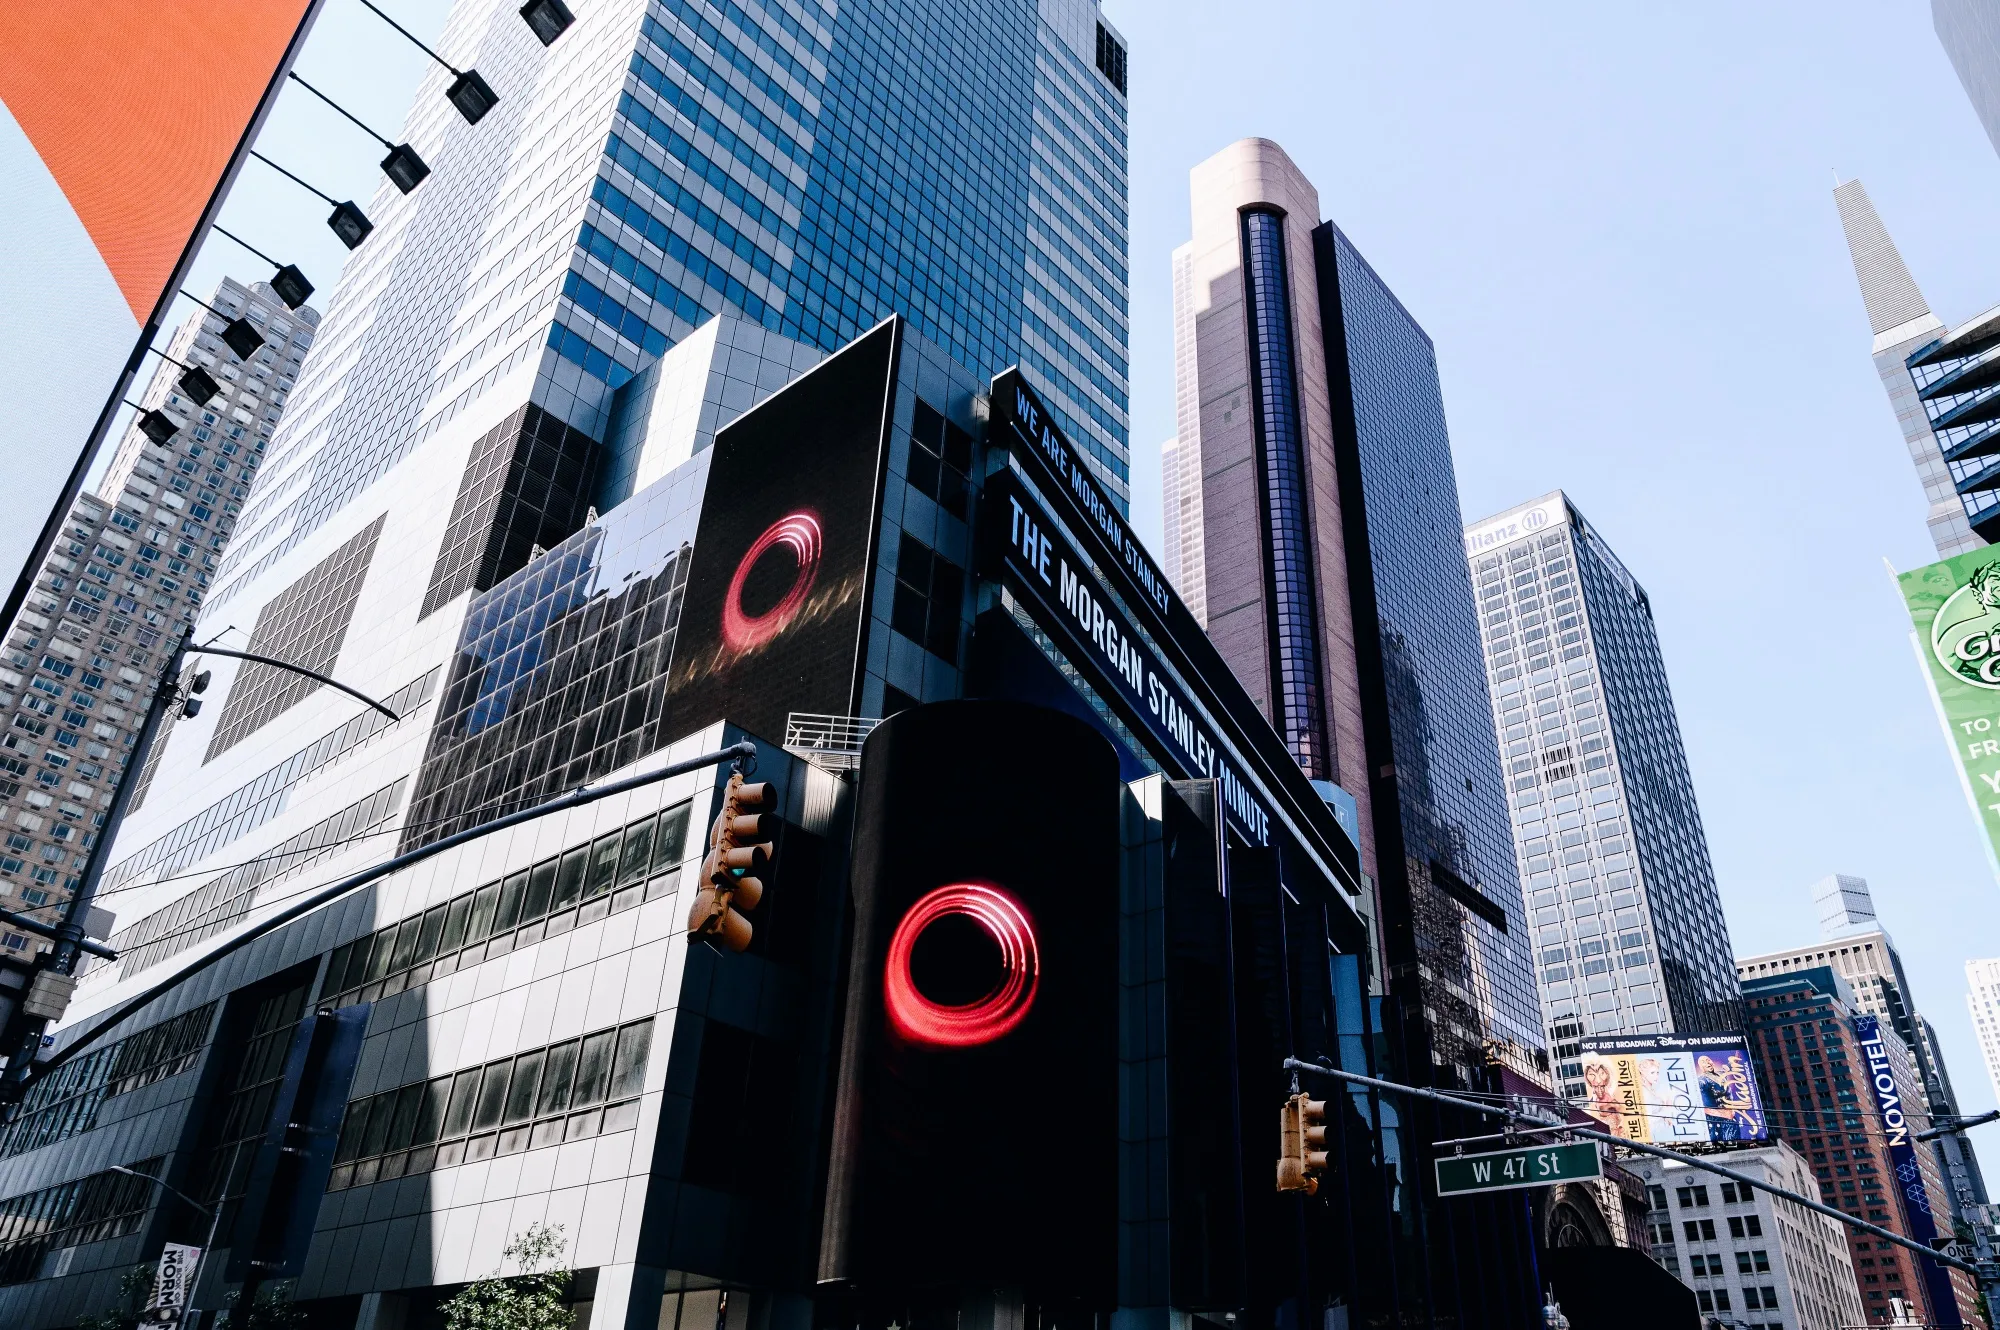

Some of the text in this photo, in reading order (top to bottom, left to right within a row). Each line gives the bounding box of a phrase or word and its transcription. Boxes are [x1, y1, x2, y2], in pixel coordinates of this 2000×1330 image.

[1016, 386, 1169, 616] WE ARE MORGAN STANLEY
[1465, 523, 1518, 552] llianz
[1010, 494, 1270, 848] THE MORGAN STANLEY MINUTE
[1960, 718, 1991, 735] TO
[1582, 1042, 1597, 1050] NOT
[1599, 1041, 1615, 1049] JUST
[1616, 1039, 1657, 1049] BROADWAY,
[1656, 1036, 1686, 1049] Disney
[1701, 1036, 1742, 1045] BROADWAY
[1617, 1060, 1634, 1087] KING
[1861, 1028, 1907, 1147] NOVOTEL
[1663, 1057, 1699, 1136] FROZEN
[1720, 1055, 1758, 1136] Aladdin
[1628, 1119, 1642, 1139] THE
[1472, 1152, 1561, 1183] W 47 St
[1947, 1245, 1973, 1258] ONE
[174, 1268, 182, 1290] BOOK
